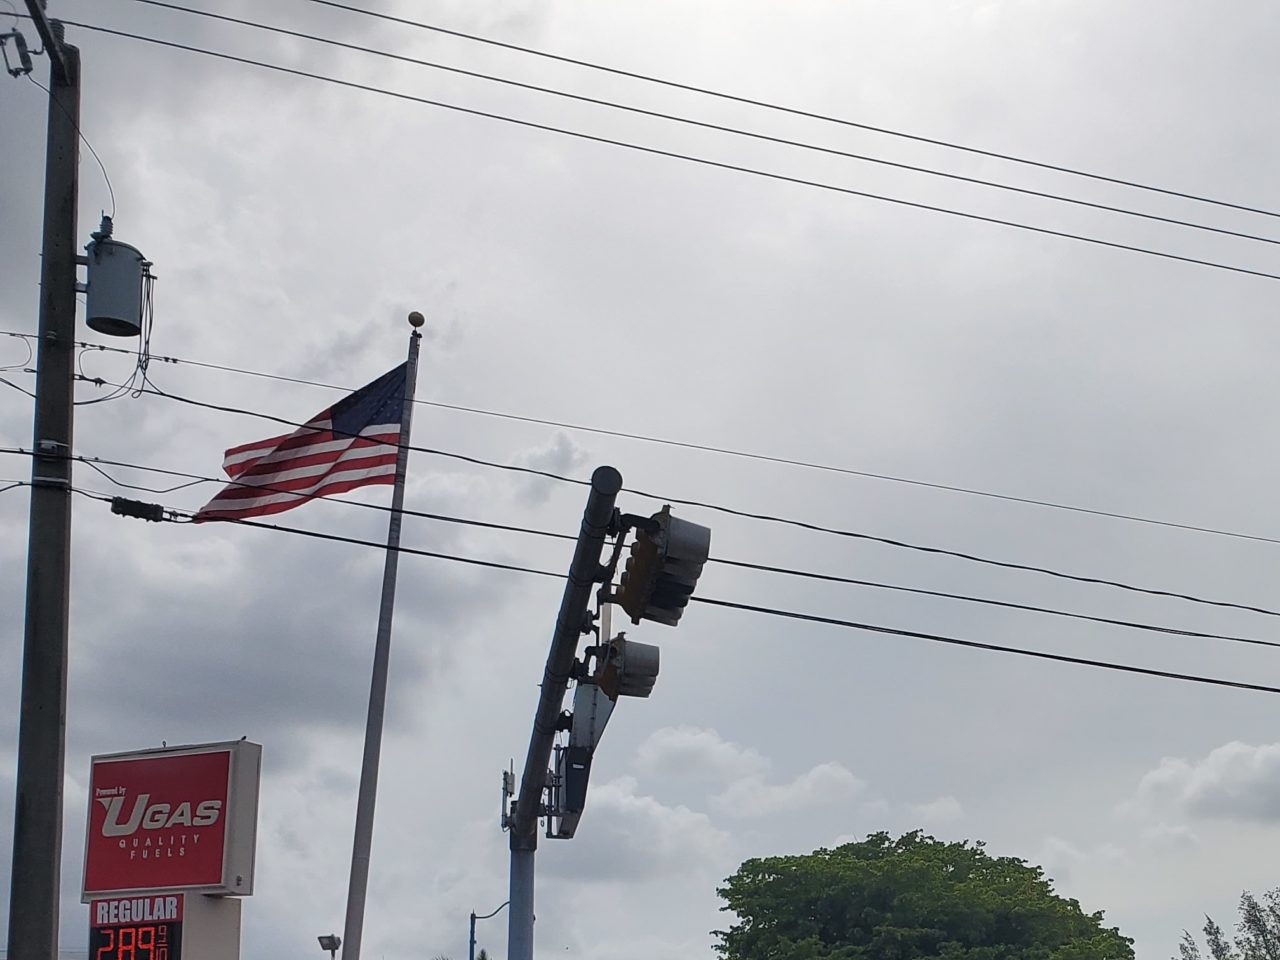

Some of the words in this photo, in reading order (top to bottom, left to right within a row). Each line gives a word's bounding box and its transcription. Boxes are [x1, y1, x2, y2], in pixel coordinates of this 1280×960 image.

[119, 834, 199, 848] QUALITY
[130, 847, 185, 860] FUELS
[97, 897, 178, 924] REGULAR
